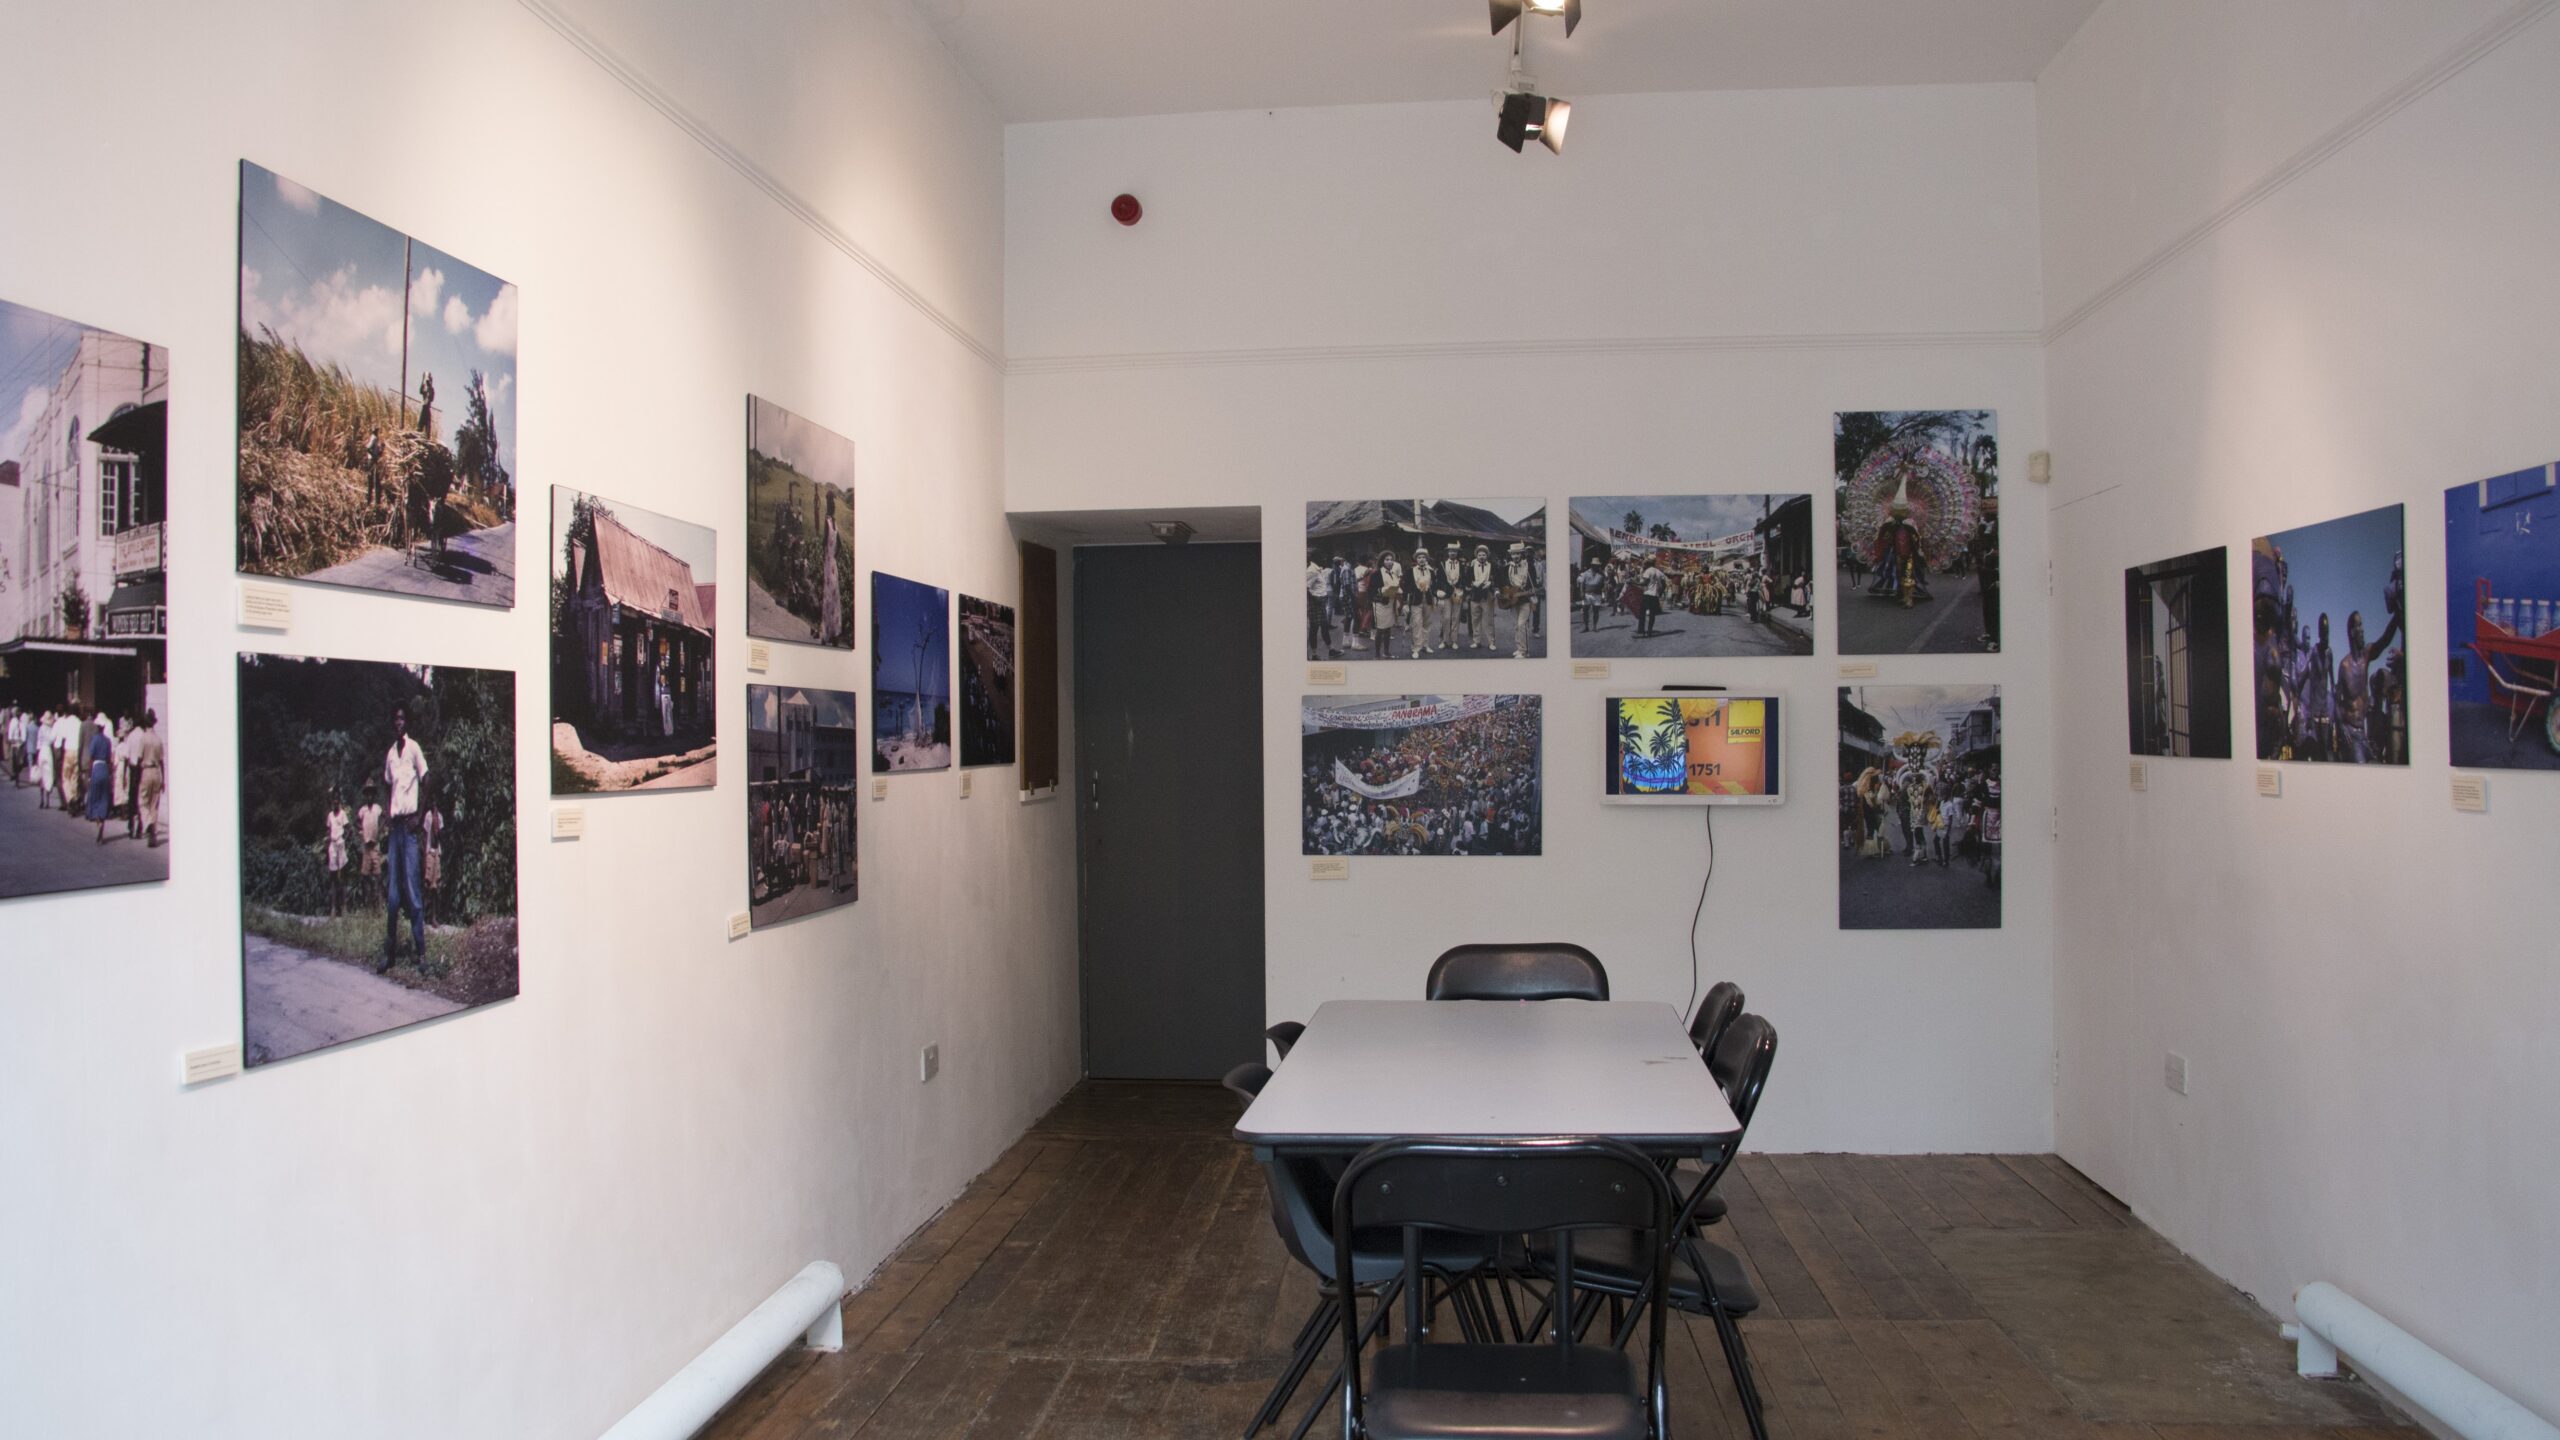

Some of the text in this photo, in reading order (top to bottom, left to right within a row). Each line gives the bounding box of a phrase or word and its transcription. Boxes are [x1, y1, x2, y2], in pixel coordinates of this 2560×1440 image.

[1725, 532, 1755, 545] ORCH
[1392, 704, 1437, 719] PANORAMA
[1689, 763, 1721, 776] 1751
